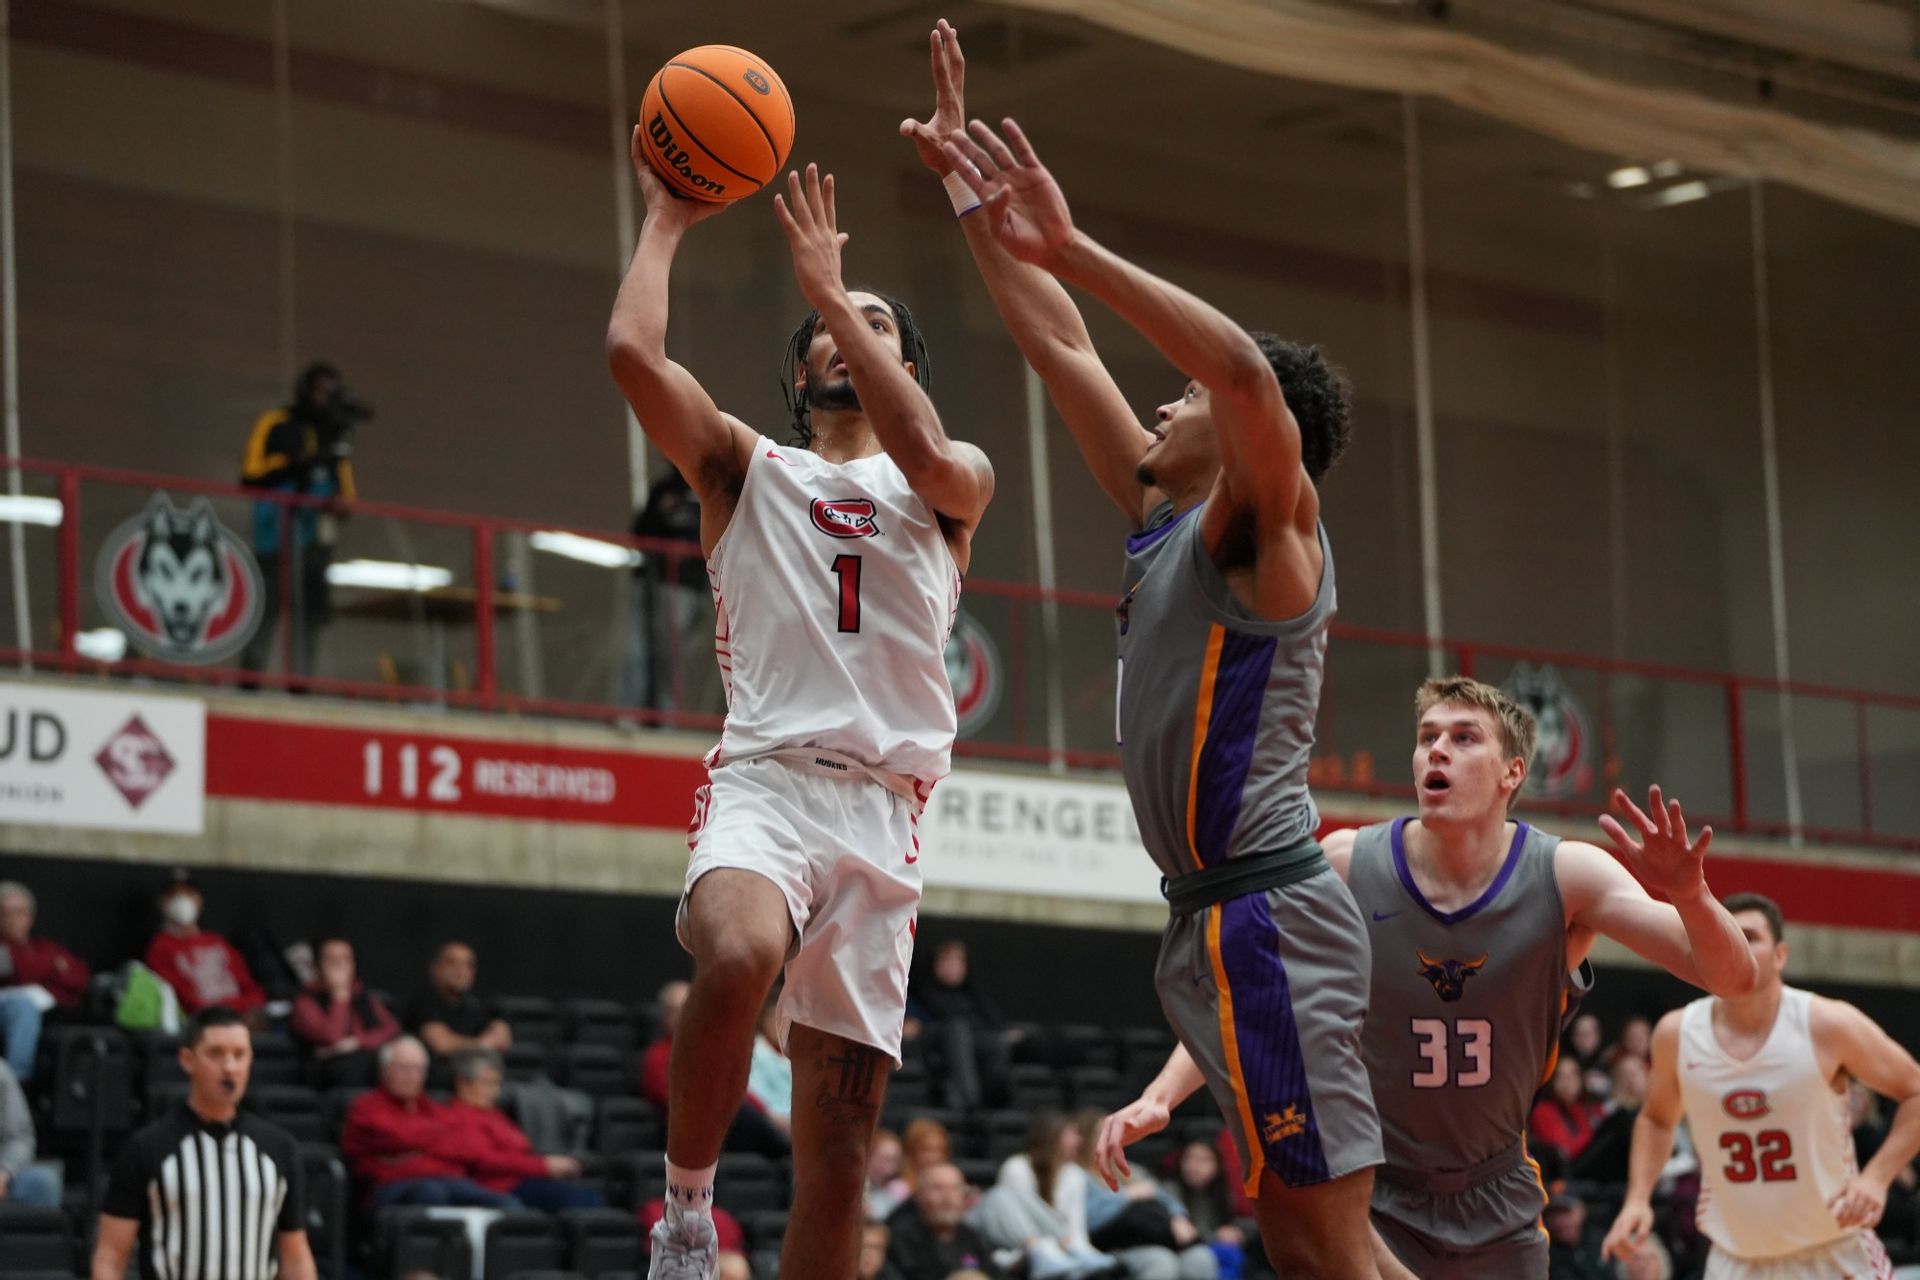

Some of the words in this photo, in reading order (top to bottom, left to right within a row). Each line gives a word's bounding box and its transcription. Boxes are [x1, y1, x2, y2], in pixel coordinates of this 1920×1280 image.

[650, 112, 725, 195] Wilson
[831, 554, 862, 634] 1
[364, 738, 462, 802] 112
[473, 757, 616, 804] RESERVED
[815, 757, 848, 771] HUSKIES
[1411, 1016, 1493, 1089] 33
[1719, 1128, 1798, 1183] 32
